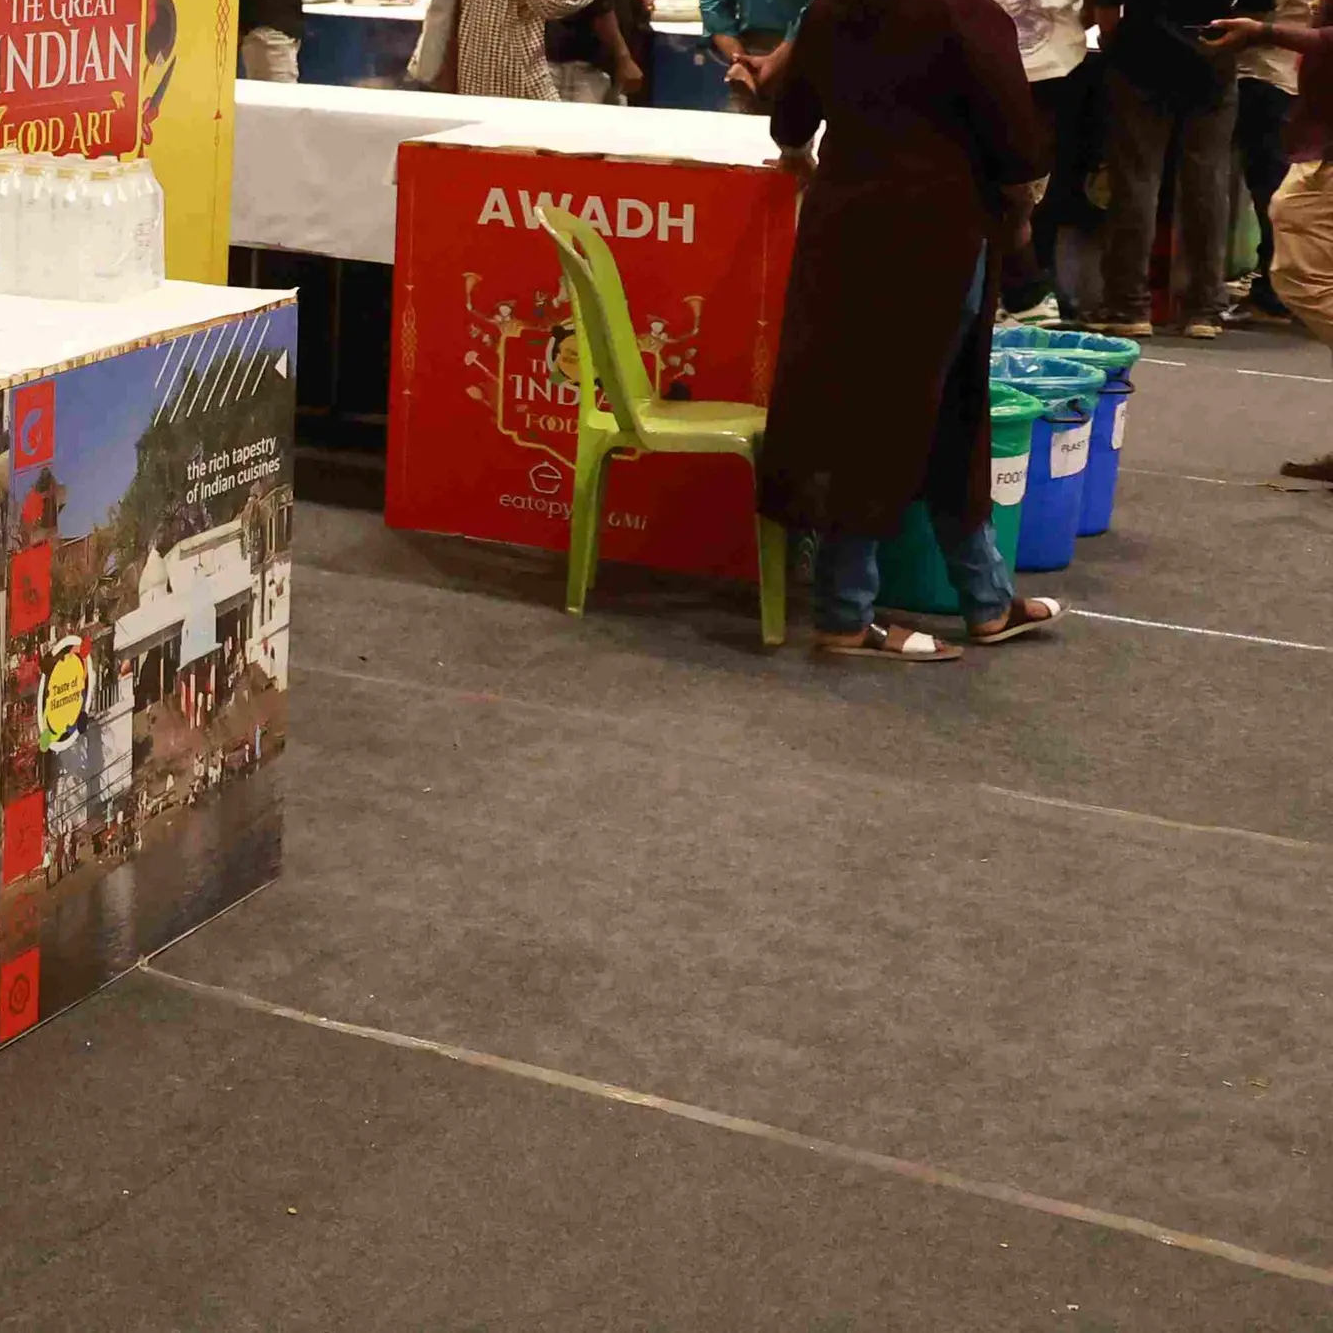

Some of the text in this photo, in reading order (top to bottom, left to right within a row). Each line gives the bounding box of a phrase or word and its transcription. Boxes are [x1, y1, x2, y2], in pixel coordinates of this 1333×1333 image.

[3, 109, 117, 156] FOOD ART
[186, 436, 277, 481] the rich tapestry
[186, 456, 281, 505] of Indian cuisines
[499, 494, 574, 519] eatopy
[50, 691, 80, 711] Harmony
[52, 681, 70, 696] Taste
